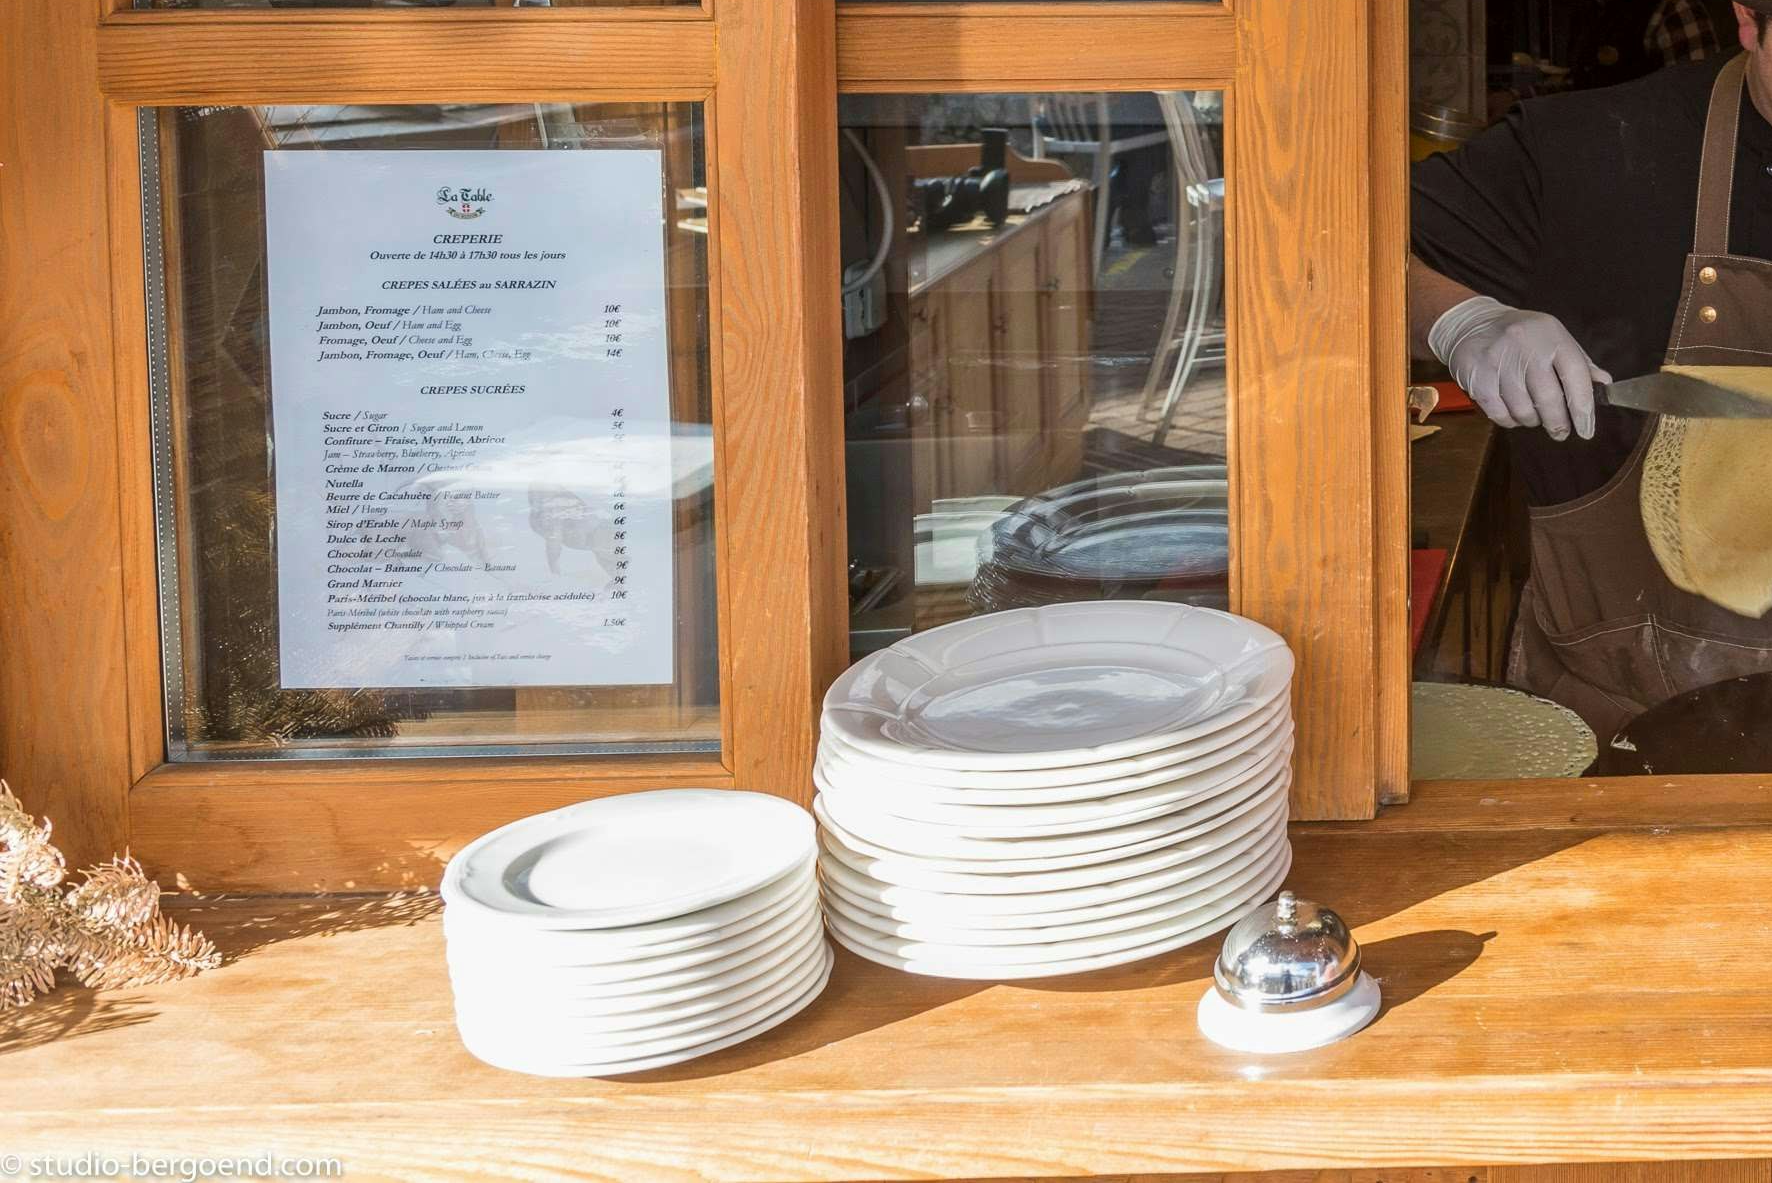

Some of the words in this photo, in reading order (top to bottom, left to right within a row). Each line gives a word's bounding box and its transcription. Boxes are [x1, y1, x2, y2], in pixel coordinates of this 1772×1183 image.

[436, 186, 458, 205] La
[459, 188, 496, 203] Table
[433, 234, 503, 244] CREPERIE
[369, 250, 411, 260] Ouverte
[413, 250, 426, 260] de
[428, 250, 457, 260] 14h30
[459, 250, 466, 260] à
[469, 250, 498, 260] 17h30
[499, 251, 521, 260] tous
[524, 250, 538, 260] les
[539, 251, 567, 261] jours
[381, 280, 429, 290] CREPES
[431, 278, 477, 290] SALÉES
[479, 282, 492, 290] au
[494, 280, 557, 290] SARRAZIN
[316, 305, 361, 317] Jambon,
[364, 305, 410, 317] Fromage
[422, 306, 446, 315] Ham
[449, 305, 463, 315] and
[464, 305, 492, 315] Cheese
[604, 304, 621, 314] 10€
[316, 321, 362, 332] Jambon,
[364, 320, 393, 330] Oeuf
[402, 321, 425, 330] Ham
[426, 320, 442, 330] and
[444, 320, 462, 332] Egg
[319, 335, 368, 347] Fromage,
[371, 335, 399, 345] Oeuf
[408, 335, 436, 345] Cheese
[437, 335, 454, 345] and
[455, 335, 473, 347] Egg
[317, 351, 362, 362] Jambon,
[365, 350, 415, 361] Fromage,
[417, 349, 446, 359] Oeuf
[606, 348, 623, 358] 14€
[420, 385, 468, 395] CREPES
[470, 383, 526, 394] SUCRÉES
[323, 411, 351, 420] Sucre
[364, 411, 388, 421] Sugar
[611, 408, 624, 417] 4€
[323, 423, 352, 433] Sucre
[354, 425, 365, 433] et
[367, 423, 400, 433] Citron
[409, 423, 435, 434] Sugar
[436, 423, 453, 432] and
[455, 423, 484, 432] Lemon
[324, 436, 373, 445] Confiture
[384, 436, 418, 446] Fraise,
[421, 435, 464, 446] Myrtille,
[466, 435, 505, 444] Abricot
[361, 464, 375, 473] de
[376, 464, 415, 473] Marron
[325, 479, 364, 488] Nutella
[326, 492, 361, 501] Beurre
[363, 492, 376, 501] de
[326, 505, 350, 514] Miel
[326, 520, 353, 531] Sirop
[613, 516, 626, 525] 6€
[326, 534, 357, 544] Dulce
[359, 534, 373, 543] de
[375, 534, 407, 543] Leche
[613, 531, 627, 540] 8€
[327, 549, 373, 558] Chocolat
[614, 546, 627, 555] 8€
[327, 564, 373, 574] Chocolat
[384, 564, 423, 573] Banane
[327, 579, 359, 589] Grand
[361, 579, 403, 588] Marnier
[327, 593, 397, 603] Paris-Méribel
[399, 593, 441, 604] (chocolat
[442, 594, 471, 604] blanc,
[327, 621, 382, 631] Supplément
[384, 621, 425, 631] Chantilly
